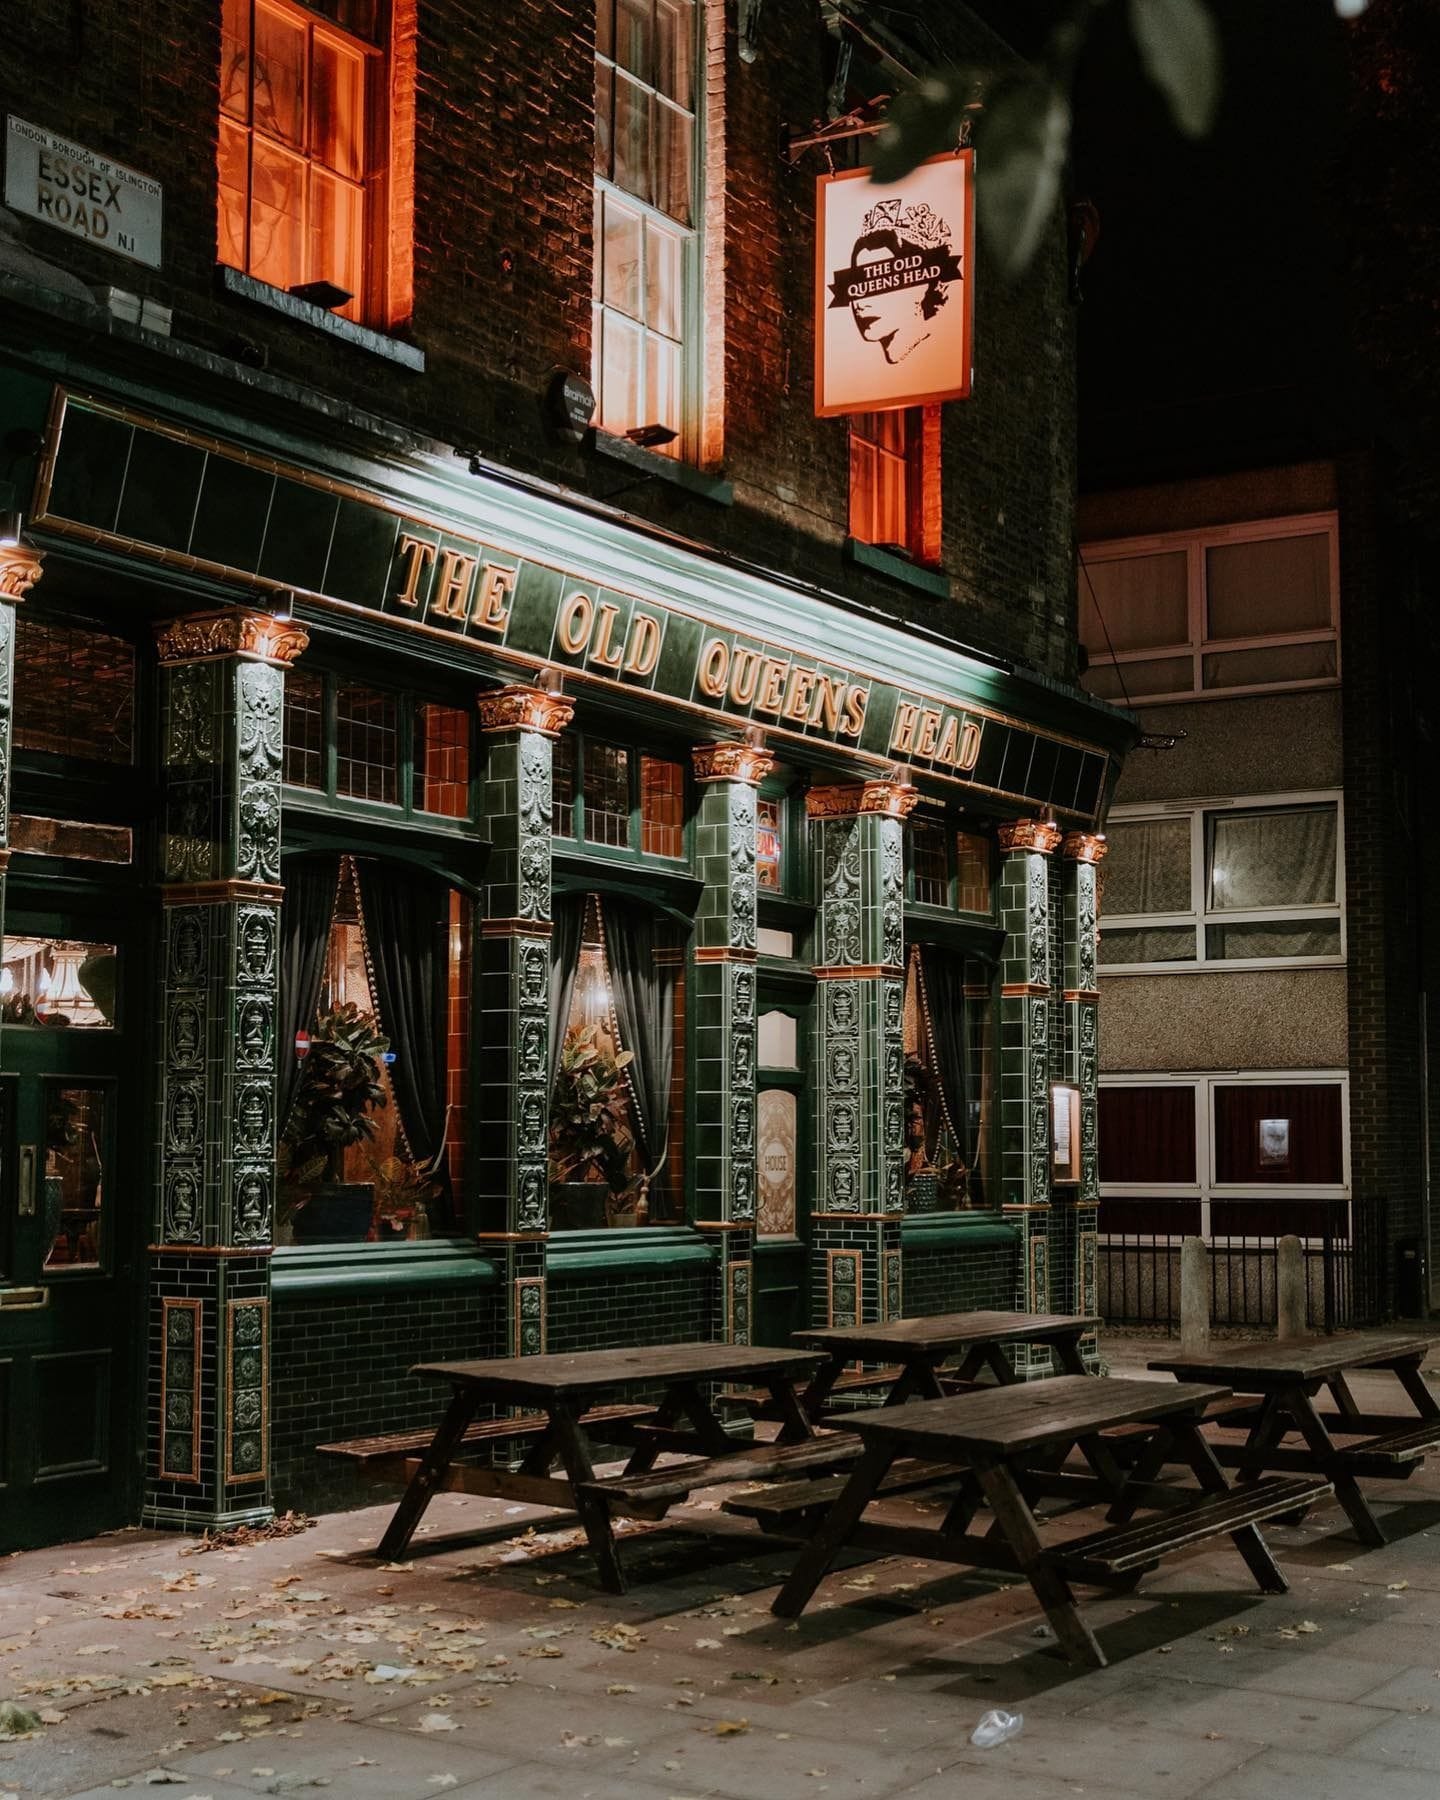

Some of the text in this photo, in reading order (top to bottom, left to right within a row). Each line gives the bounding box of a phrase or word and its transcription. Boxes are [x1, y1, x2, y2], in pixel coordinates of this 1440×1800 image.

[9, 120, 160, 197] LONDON BOROUGH OF ISLINGTON
[38, 149, 122, 214] ESSEX
[37, 182, 109, 240] ROAD
[847, 264, 941, 297] QUEENS HEAD
[863, 254, 923, 280] THE OLD
[397, 532, 983, 772] THE OLD QUEENS HEAD
[765, 1155, 787, 1171] HOUSE
